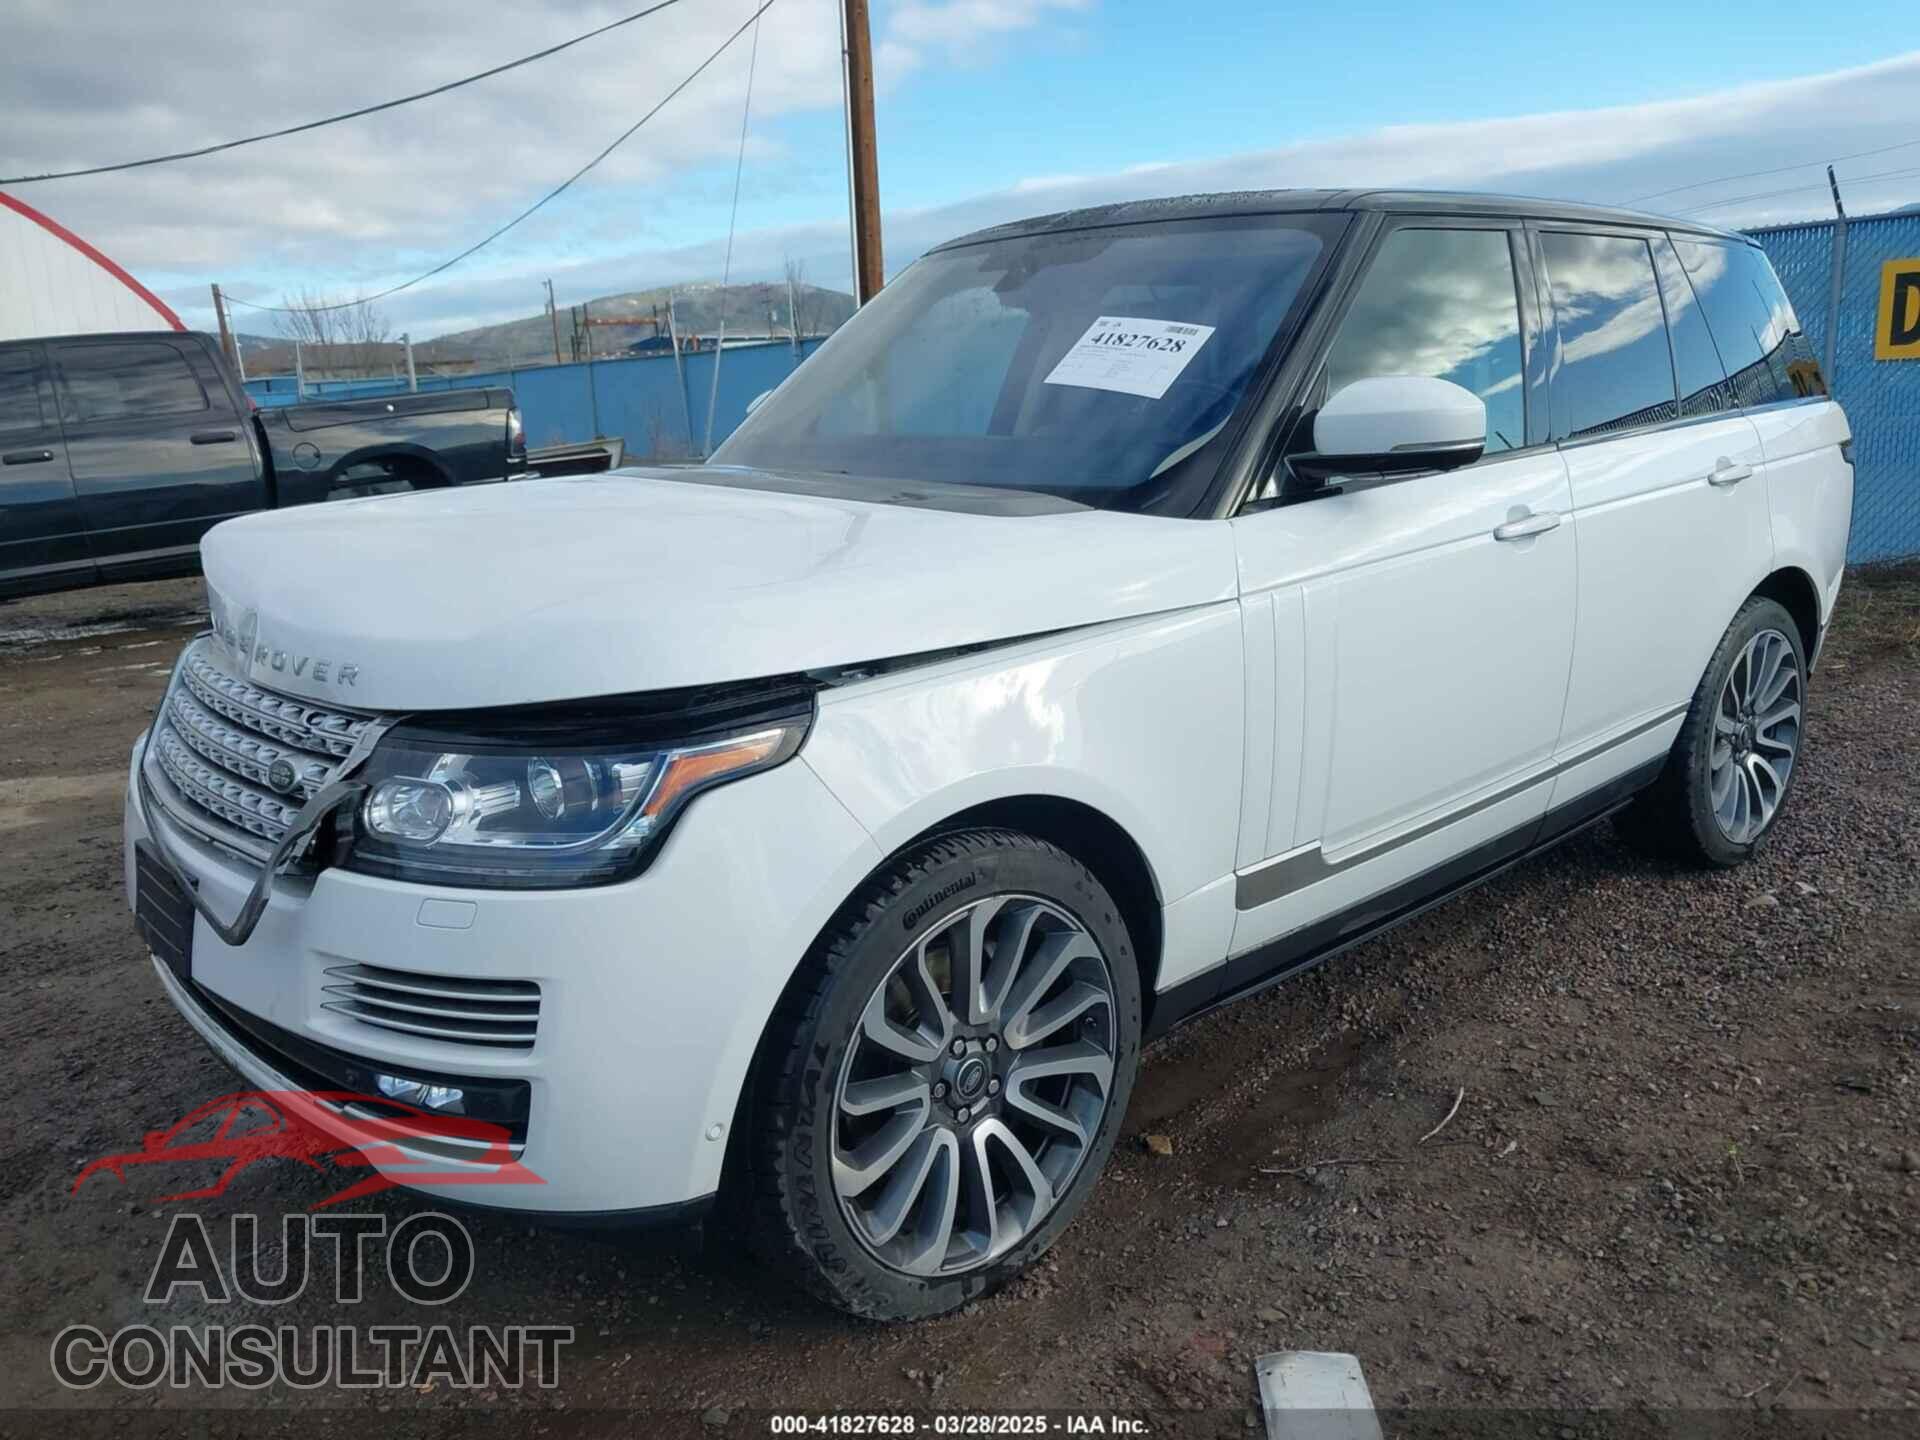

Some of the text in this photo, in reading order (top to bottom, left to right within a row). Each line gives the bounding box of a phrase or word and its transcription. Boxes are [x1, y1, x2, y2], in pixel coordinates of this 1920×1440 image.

[1091, 331, 1186, 353] 41827628
[254, 644, 361, 687] ROVER
[902, 871, 976, 931] Continental
